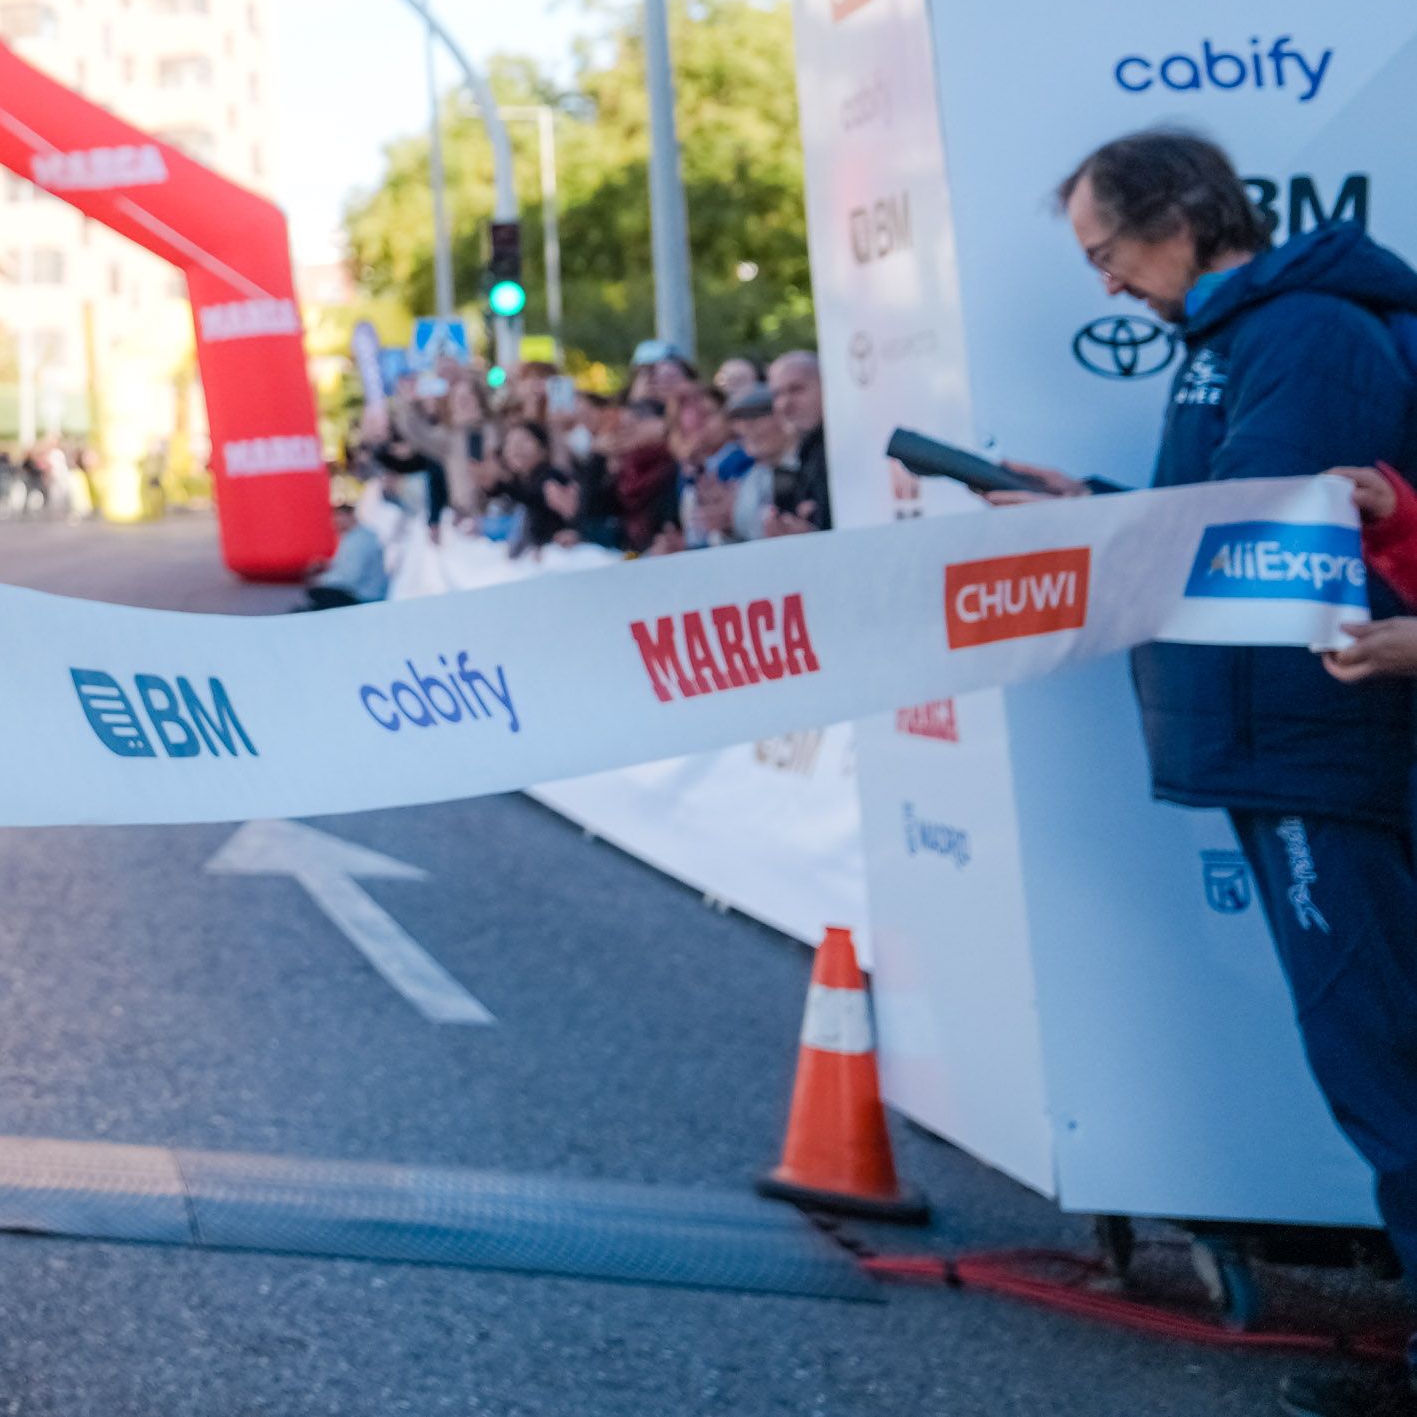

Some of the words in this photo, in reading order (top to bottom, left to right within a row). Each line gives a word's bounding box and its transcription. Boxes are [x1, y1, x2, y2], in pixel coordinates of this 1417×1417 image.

[1113, 37, 1333, 101] cabify
[1247, 176, 1368, 244] BM
[955, 572, 1077, 622] CHUWI
[1209, 541, 1367, 589] AliExpre
[630, 593, 821, 703] MARCA
[134, 672, 260, 759] BM
[359, 650, 521, 733] cabify
